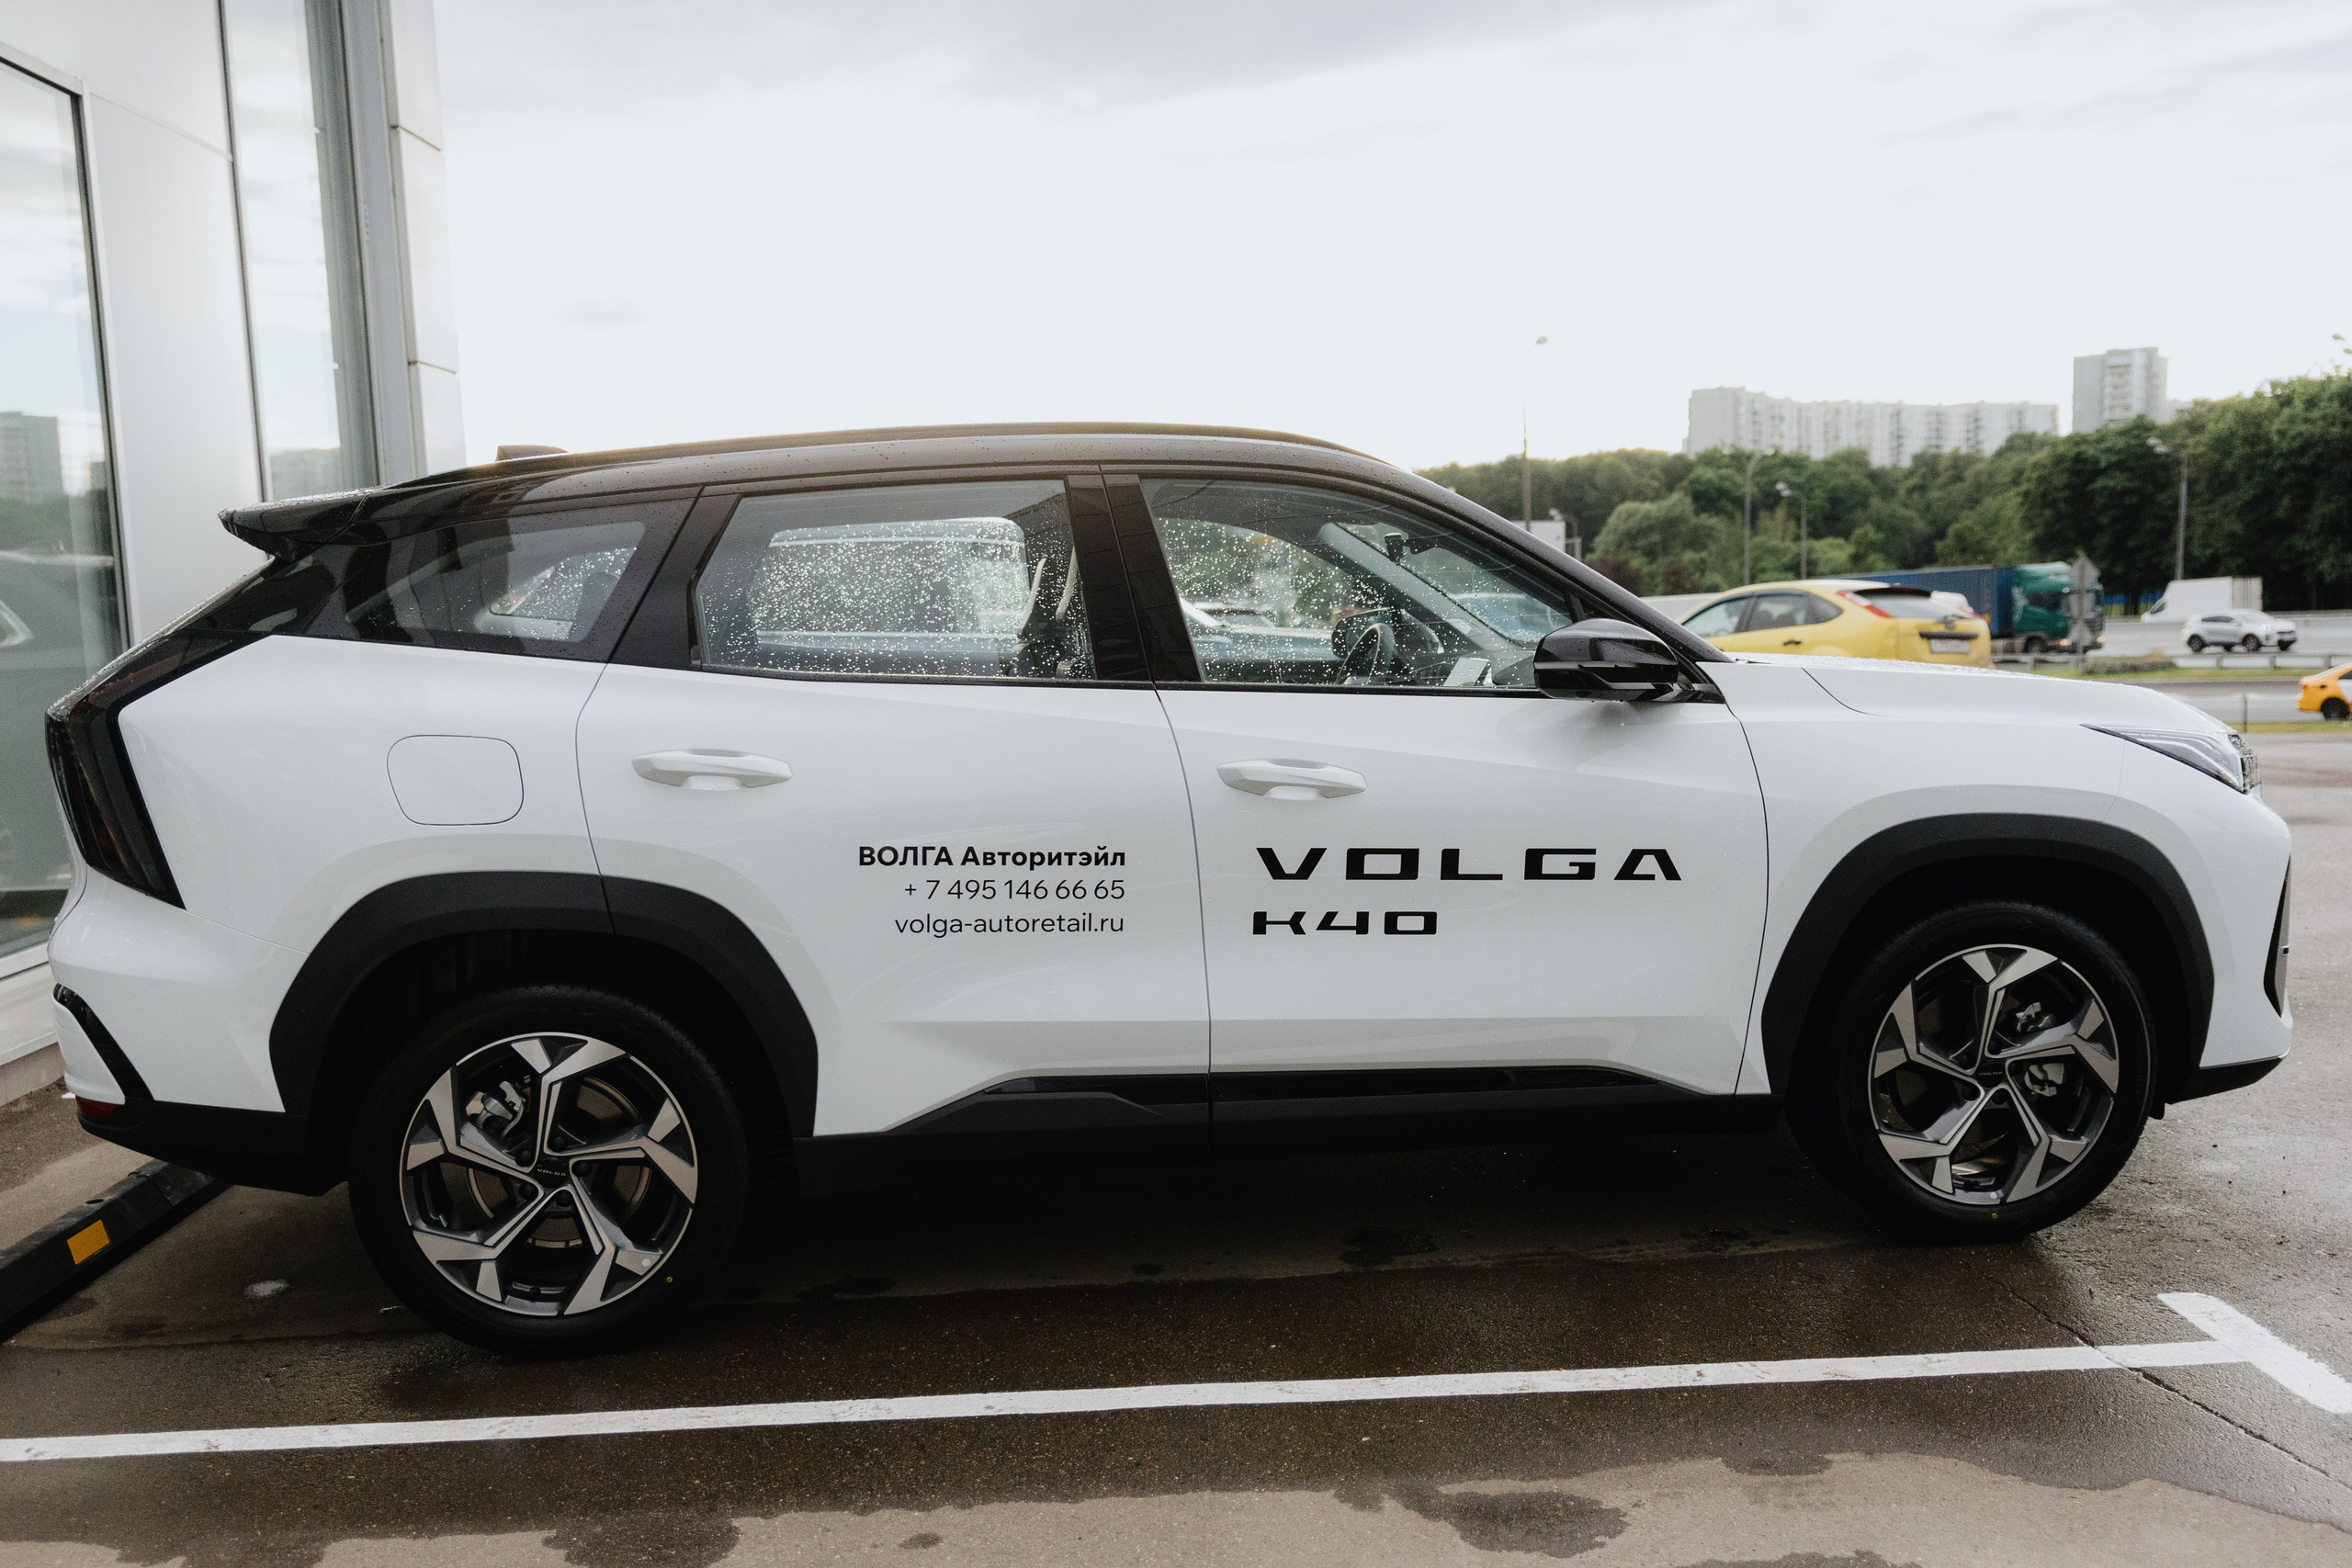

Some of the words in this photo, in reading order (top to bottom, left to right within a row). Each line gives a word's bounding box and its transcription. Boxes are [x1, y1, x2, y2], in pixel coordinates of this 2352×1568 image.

[858, 845, 955, 867] ВОЛГА
[960, 845, 1125, 872] Авторитэйл
[1255, 847, 1682, 882] VOLGA
[904, 884, 917, 897] +
[925, 879, 941, 900] 7
[946, 879, 997, 900] 495
[1003, 879, 1048, 900] 146
[1055, 879, 1088, 900] 66
[1093, 879, 1125, 900] 65
[894, 911, 1124, 939] volga-autoretail.ru
[1252, 910, 1438, 936] K40
[537, 1168, 566, 1177] VOLGA
